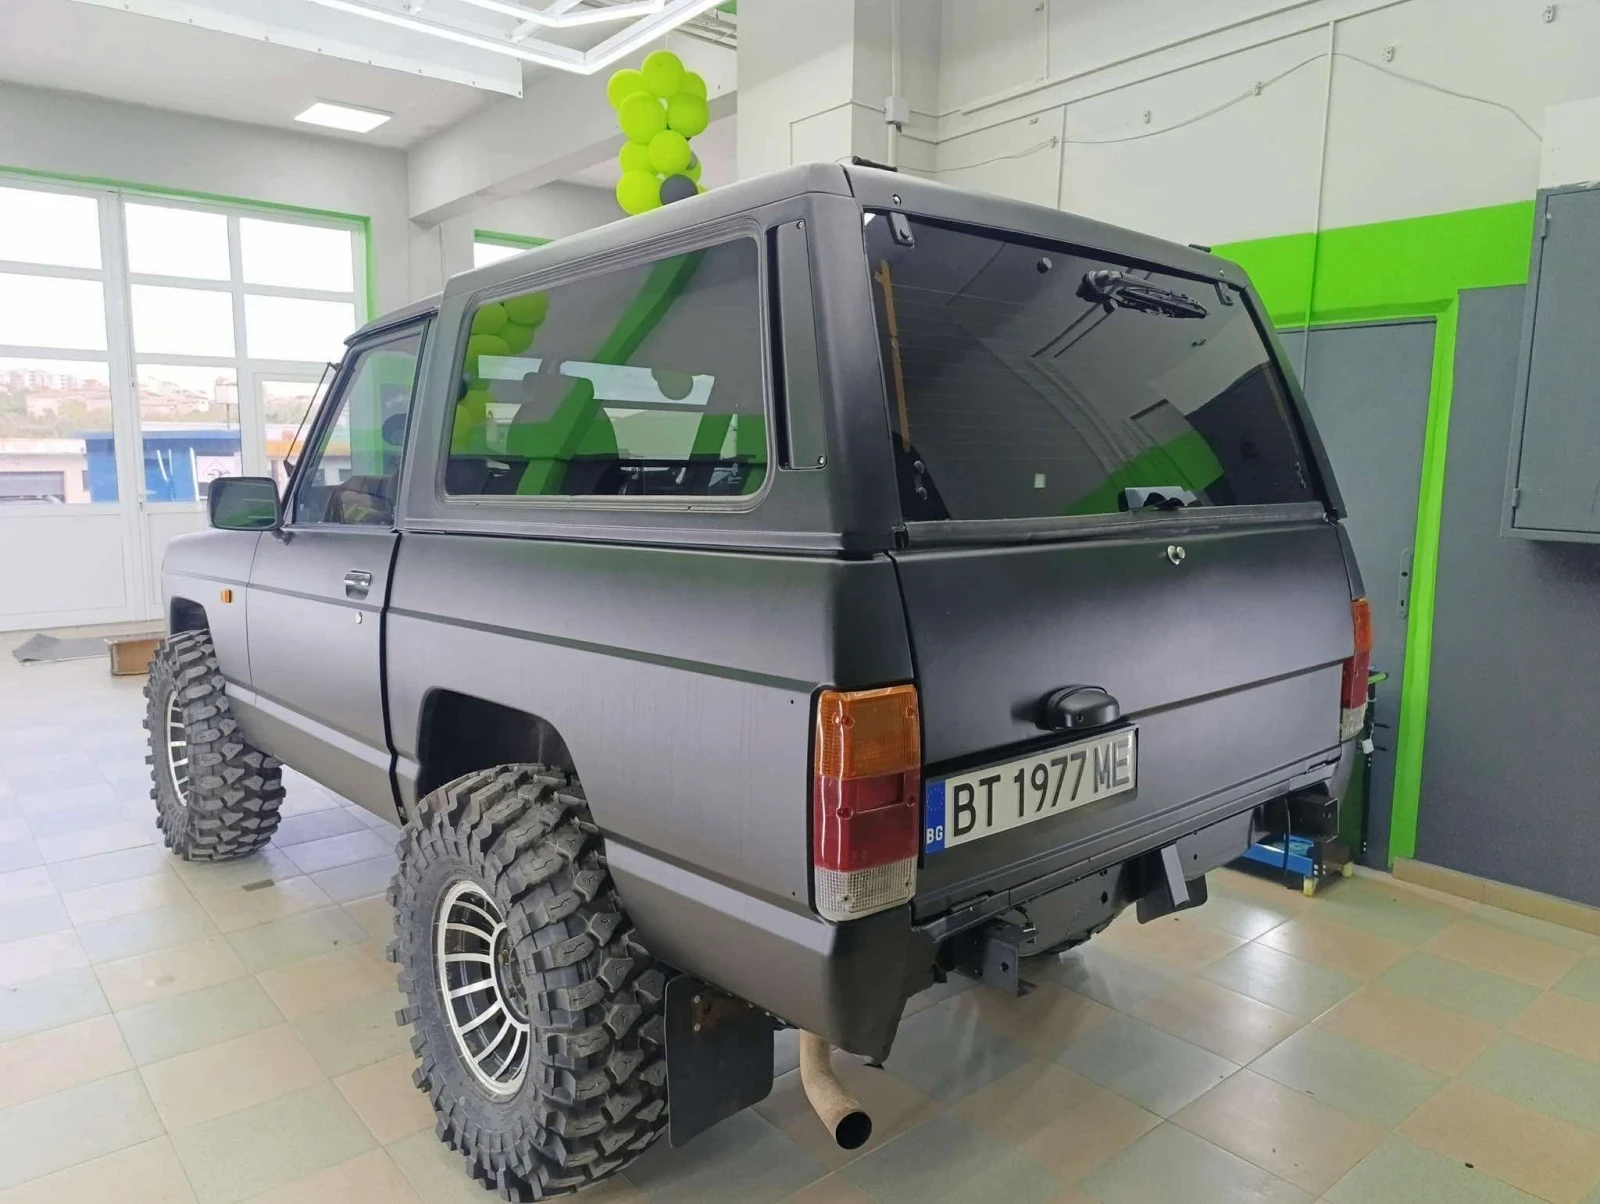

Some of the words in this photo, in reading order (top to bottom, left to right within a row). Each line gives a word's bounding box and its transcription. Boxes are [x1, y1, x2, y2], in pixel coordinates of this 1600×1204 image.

[953, 774, 1001, 837] BT
[1014, 750, 1088, 817] 1977
[1094, 740, 1130, 793] ME
[926, 825, 943, 844] BG
